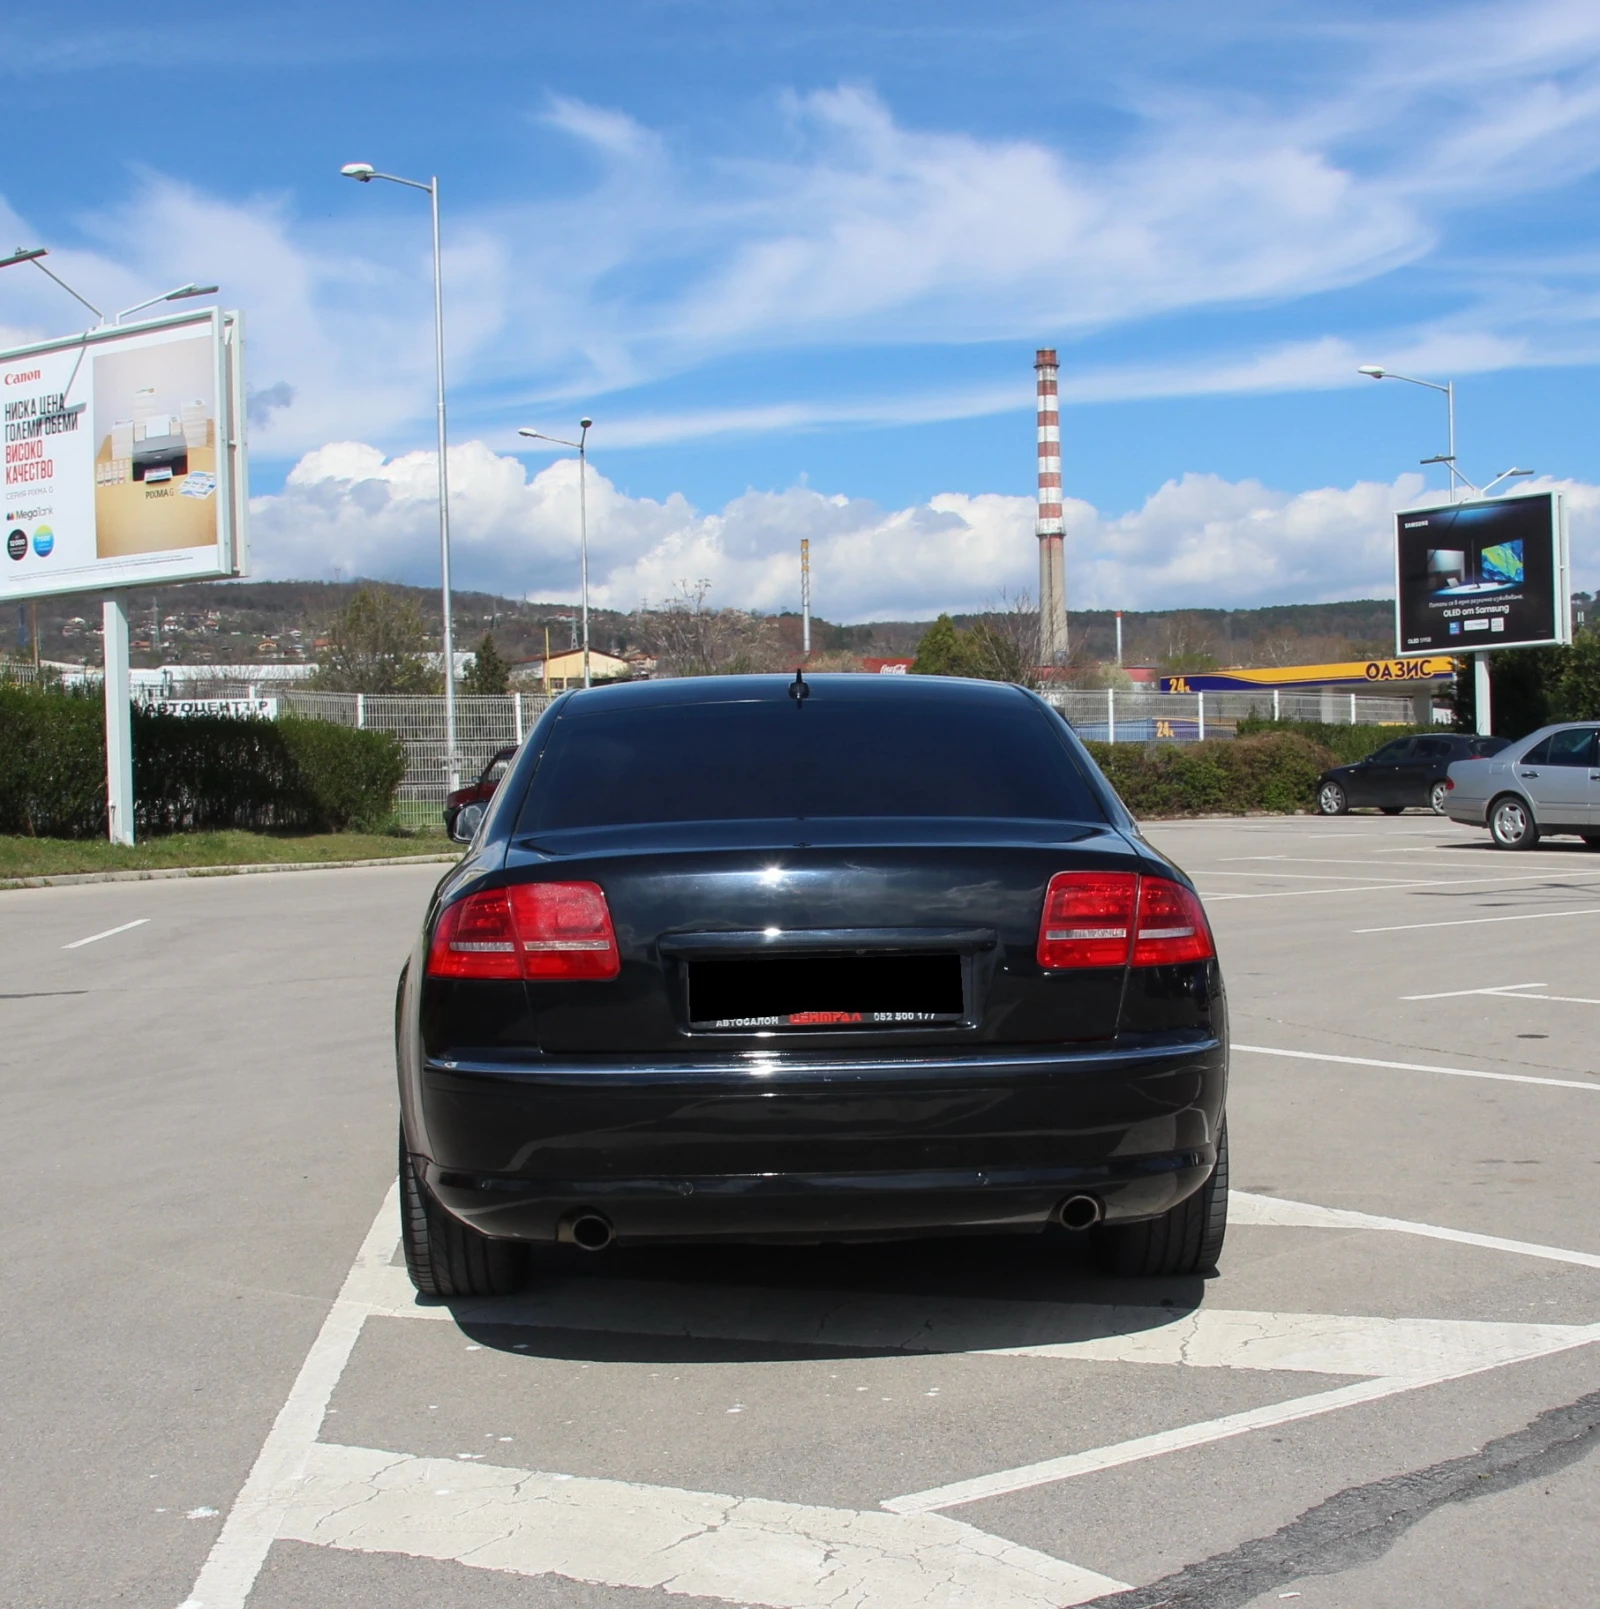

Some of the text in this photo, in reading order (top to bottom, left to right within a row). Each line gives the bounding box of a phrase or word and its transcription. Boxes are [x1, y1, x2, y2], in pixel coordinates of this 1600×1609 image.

[5, 370, 41, 385] Canon
[5, 393, 65, 421] НИСКА ЦЕНА
[5, 411, 78, 442] ГОЛЕМИ ОБЕМИ
[6, 440, 43, 464] ВИСОКО
[6, 459, 54, 485] КАЧЕСТВО
[145, 489, 169, 499] PIXMA
[16, 506, 53, 521] MegaTank
[1405, 520, 1429, 528] SAMSUNG
[1443, 608, 1461, 618] OLED
[1475, 604, 1510, 615] Samsung
[1365, 659, 1432, 680] ОАЗИС
[716, 1016, 779, 1027] АВТОСАЛОН
[874, 1012, 893, 1021] 052
[895, 1012, 914, 1020] 500
